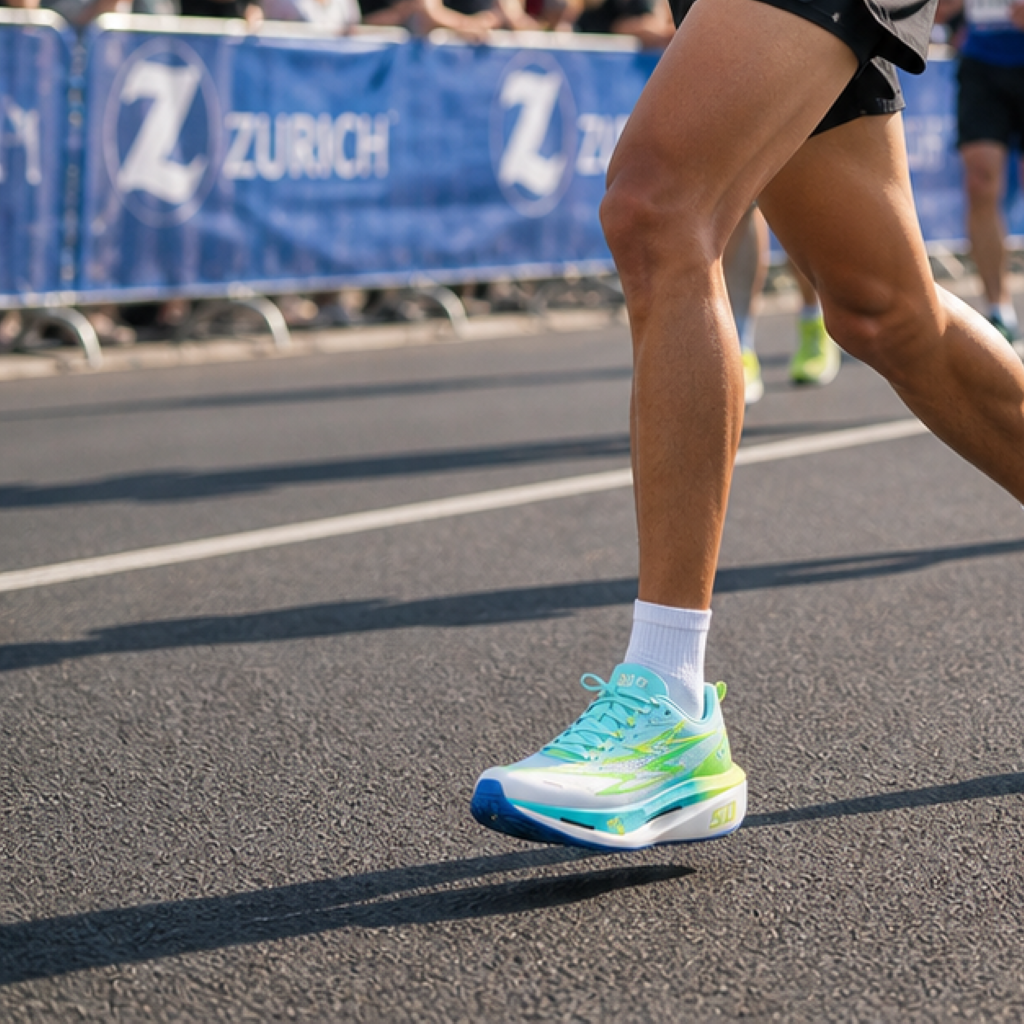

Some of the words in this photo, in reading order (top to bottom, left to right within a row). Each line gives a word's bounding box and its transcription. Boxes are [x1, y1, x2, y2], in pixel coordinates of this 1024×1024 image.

[117, 59, 208, 205] Z
[222, 111, 390, 182] ZURICH
[500, 70, 567, 197] Z
